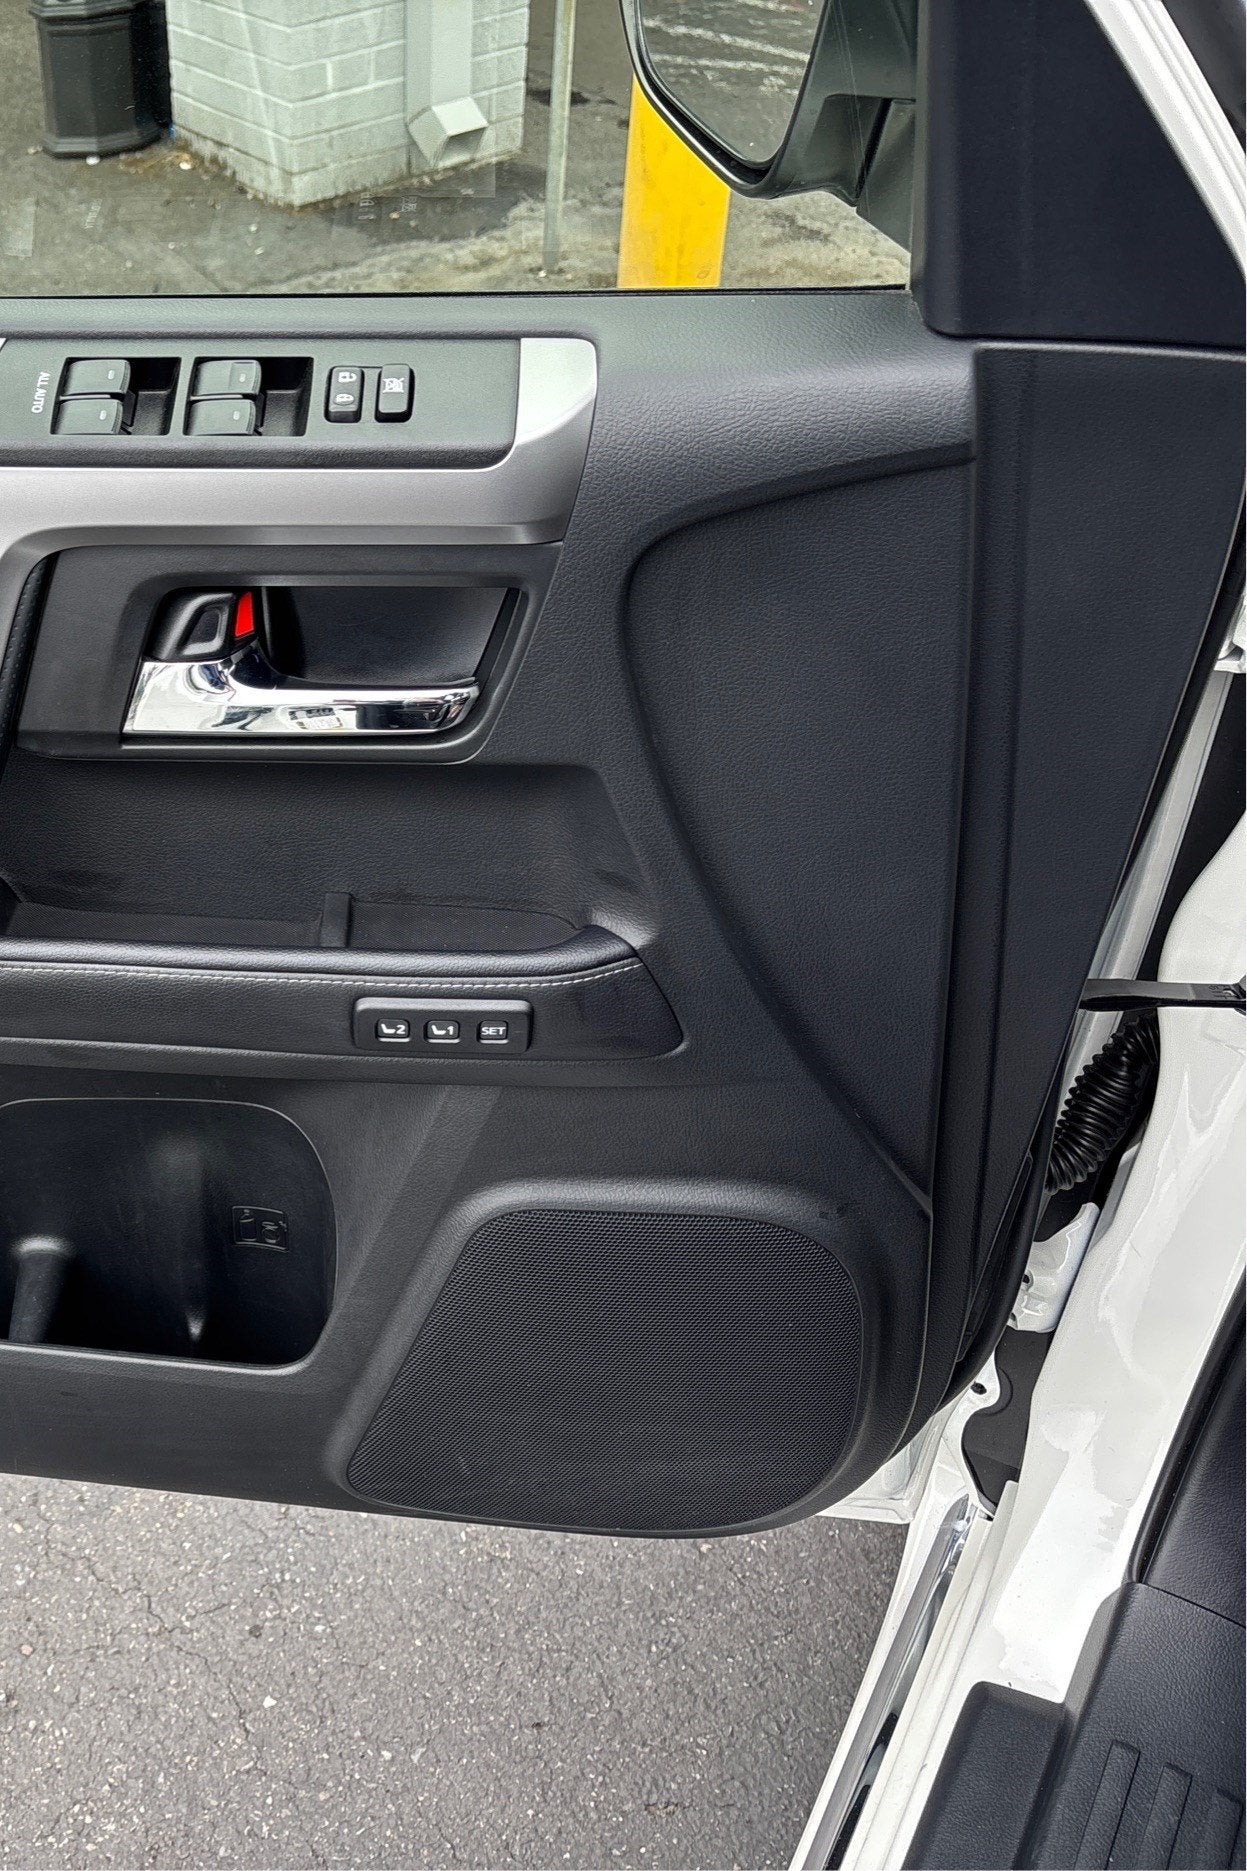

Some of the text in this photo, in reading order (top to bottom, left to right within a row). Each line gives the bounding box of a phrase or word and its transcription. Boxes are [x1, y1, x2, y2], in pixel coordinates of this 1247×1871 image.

[31, 371, 51, 414] ALL AUTO
[396, 1024, 406, 1035] 2
[447, 1025, 454, 1035] 1
[481, 1026, 506, 1036] SET
